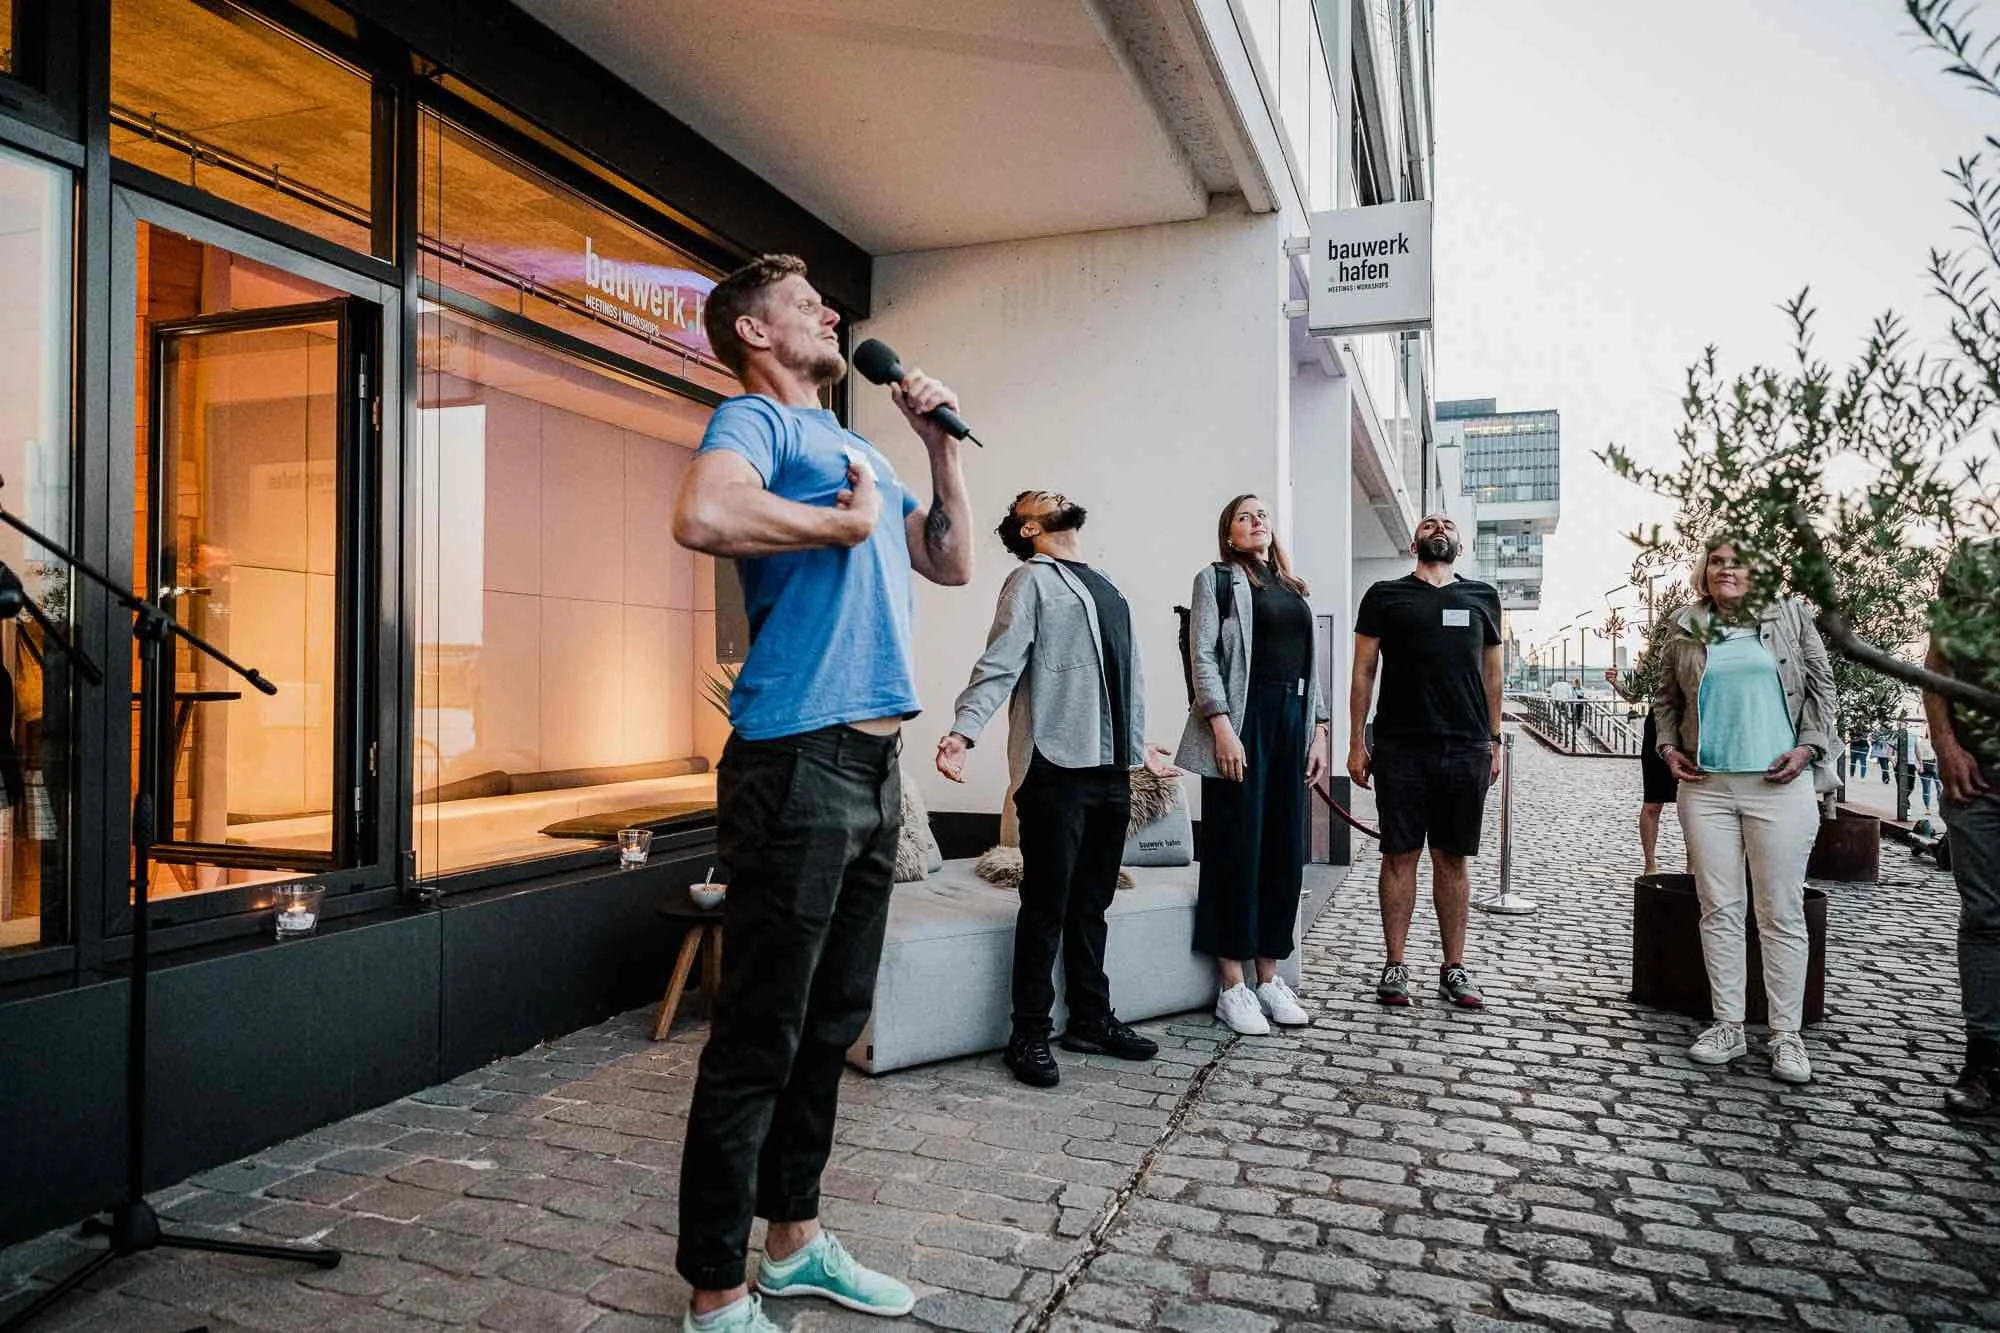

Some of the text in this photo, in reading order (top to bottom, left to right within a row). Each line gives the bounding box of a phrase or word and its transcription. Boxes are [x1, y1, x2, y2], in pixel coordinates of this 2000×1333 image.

[1328, 232, 1409, 260] bauwerk
[585, 235, 708, 339] bauwerk.h
[585, 293, 618, 319] MEETINGS
[622, 310, 661, 337] WORKSHOPS
